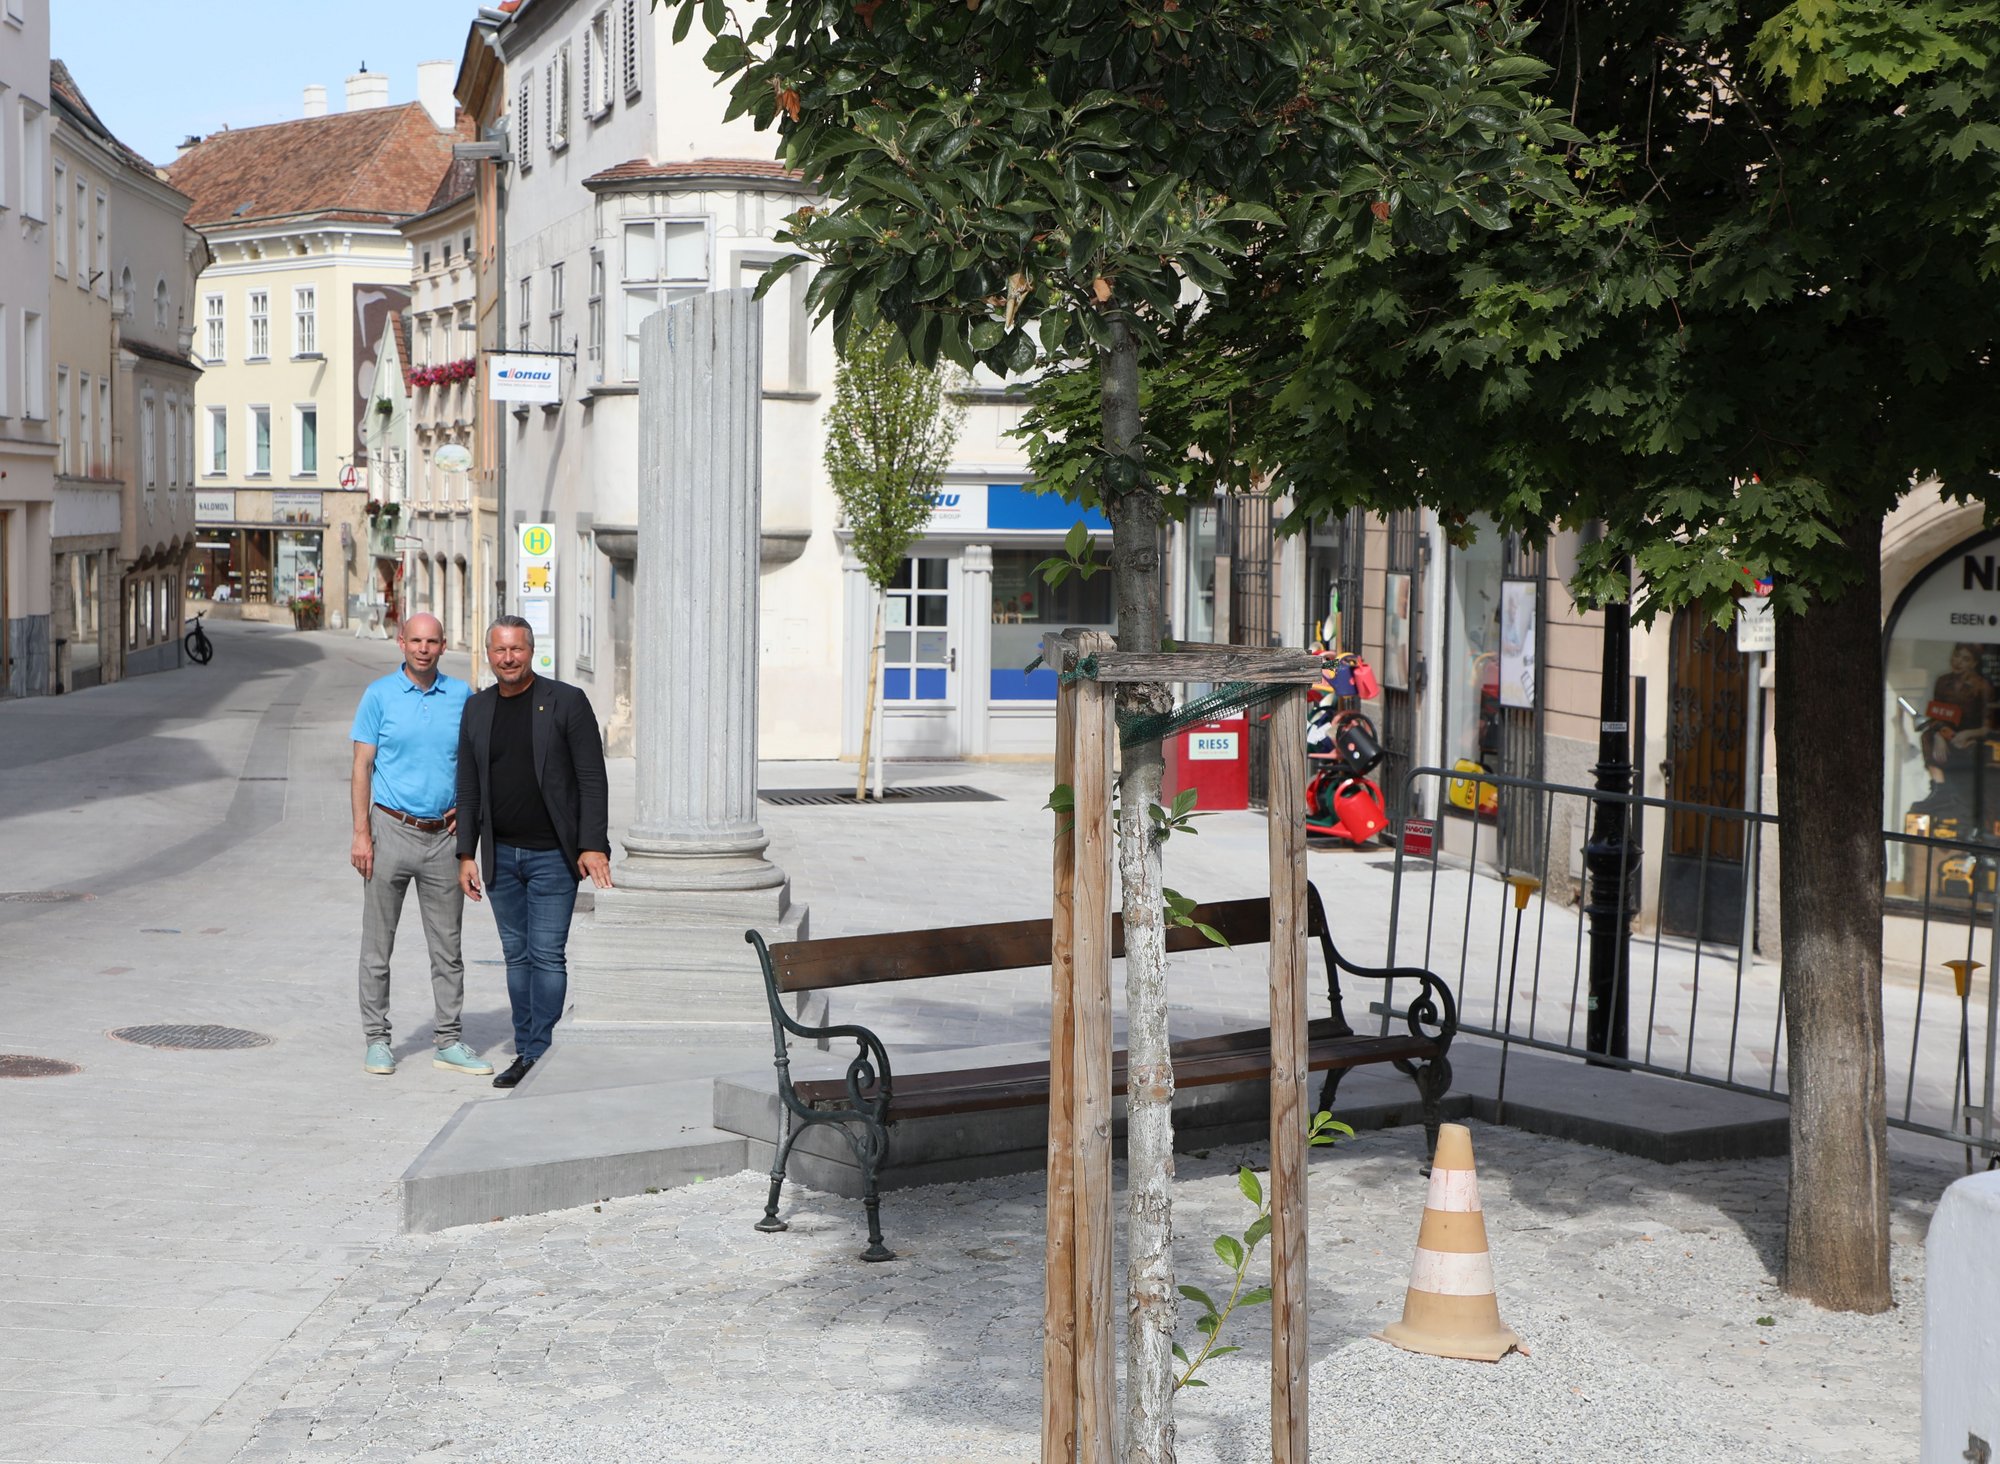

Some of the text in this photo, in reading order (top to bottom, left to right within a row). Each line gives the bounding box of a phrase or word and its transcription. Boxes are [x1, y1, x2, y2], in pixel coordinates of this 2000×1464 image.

[199, 502, 228, 511] SALOMON
[530, 532, 545, 549] H
[543, 561, 551, 572] 4
[1963, 555, 2000, 591] N
[523, 581, 531, 593] 5
[543, 581, 552, 593] 6
[1950, 613, 1985, 625] EISEN
[1198, 739, 1230, 750] RIESS
